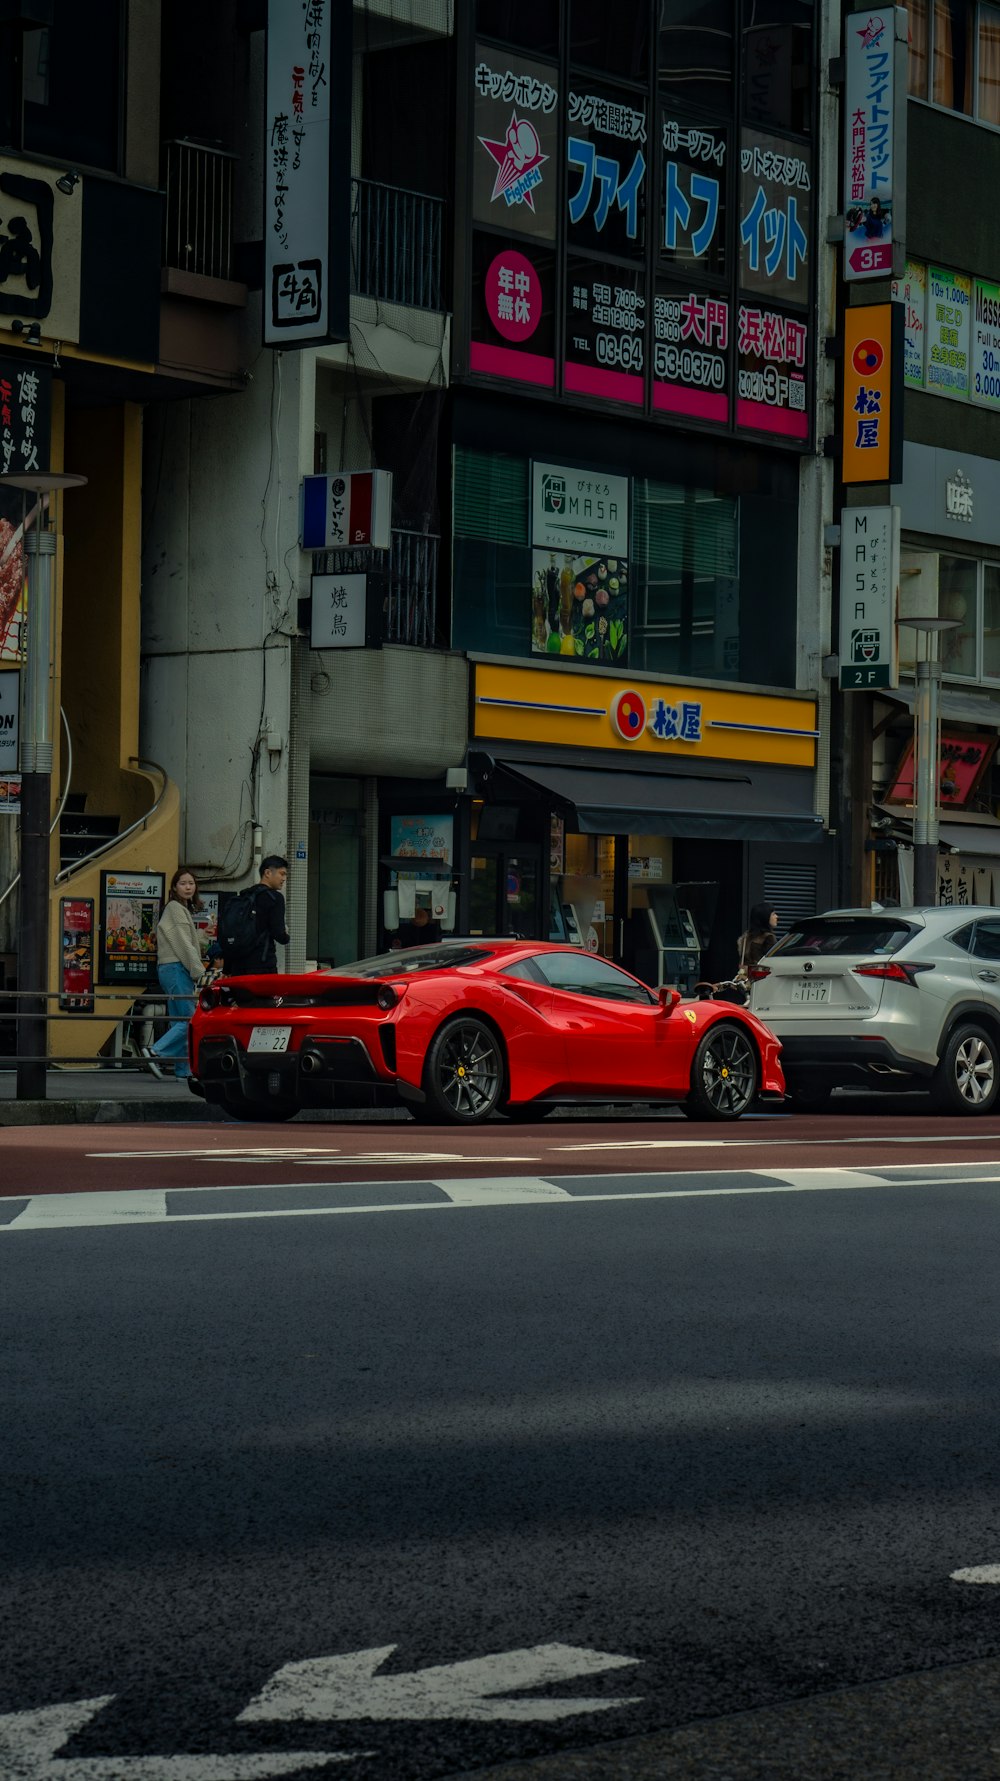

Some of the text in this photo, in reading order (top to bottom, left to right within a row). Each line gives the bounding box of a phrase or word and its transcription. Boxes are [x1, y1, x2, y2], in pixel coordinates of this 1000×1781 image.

[866, 53, 889, 189] ファイトフィット
[851, 108, 866, 200] 大門浜松町
[503, 168, 542, 205] FightFit
[860, 249, 883, 269] 3F
[280, 274, 317, 311] 牛角
[498, 266, 530, 298] 年中
[498, 292, 531, 325] 無休
[573, 336, 591, 351] TEL
[681, 293, 807, 367] 大門 浜松町
[978, 330, 990, 346] Full
[853, 386, 881, 449] 松屋
[577, 480, 610, 496] びすとろ
[569, 496, 618, 522] MASA
[355, 530, 367, 542] 2F
[855, 516, 867, 620] MASA
[870, 538, 879, 594] びすとろ
[331, 586, 348, 637] 焼鳥
[854, 671, 876, 684] 2F
[651, 697, 704, 742] 松屋
[146, 886, 158, 895] 4F
[209, 900, 218, 909] 4F
